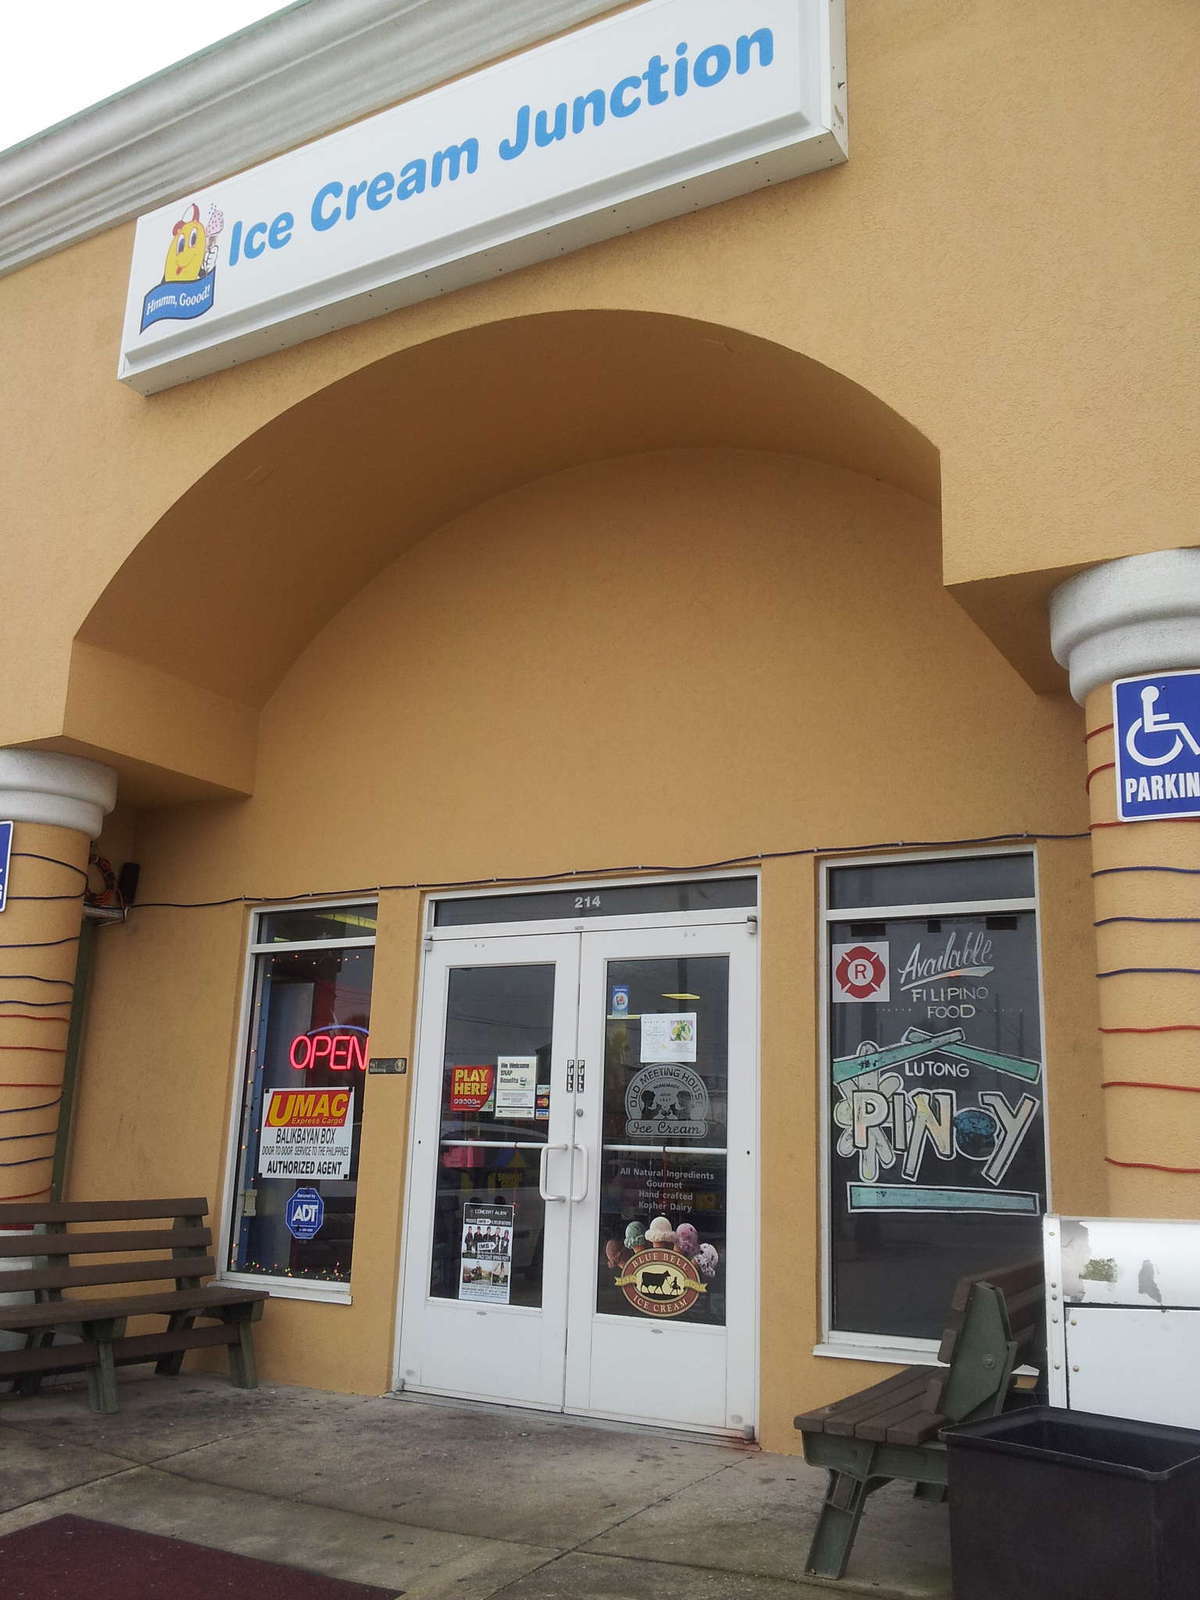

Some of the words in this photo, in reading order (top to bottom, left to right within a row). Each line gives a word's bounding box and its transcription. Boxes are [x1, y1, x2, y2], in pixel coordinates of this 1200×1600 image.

[229, 211, 295, 266] Ice
[311, 137, 479, 233] Cream
[498, 26, 774, 162] Junction
[574, 895, 601, 909] 214
[898, 931, 993, 984] Available
[854, 963, 867, 980] R
[911, 986, 990, 1003] FILIPINO
[927, 1003, 976, 1020] FOOD
[290, 1035, 369, 1070] OPEN
[454, 1069, 489, 1083] PLAY
[904, 1060, 970, 1079] LUTONG
[453, 1083, 489, 1096] HERE
[629, 1085, 641, 1108] OLD
[640, 1067, 681, 1085] MEETING
[268, 1093, 349, 1127] UMAC
[276, 1128, 320, 1144] BALIKBAYAN
[320, 1128, 337, 1145] BOX
[630, 1121, 655, 1134] Ice
[657, 1121, 700, 1135] Cream
[267, 1161, 316, 1175] AUTHORIZED
[316, 1162, 343, 1175] AGENT
[620, 1167, 631, 1175] All
[633, 1168, 664, 1177] Natural
[666, 1169, 715, 1180] Ingredients
[646, 1179, 683, 1189] Gourmet
[638, 1190, 660, 1199] Hand
[662, 1191, 694, 1201] crafted
[292, 1204, 319, 1222] ADT
[638, 1201, 667, 1212] Kosher
[670, 1203, 693, 1213] Dairy
[631, 1252, 660, 1269] BLUE
[663, 1252, 689, 1271] BELL
[632, 1294, 650, 1309] ICE
[653, 1299, 688, 1313] CREAM
